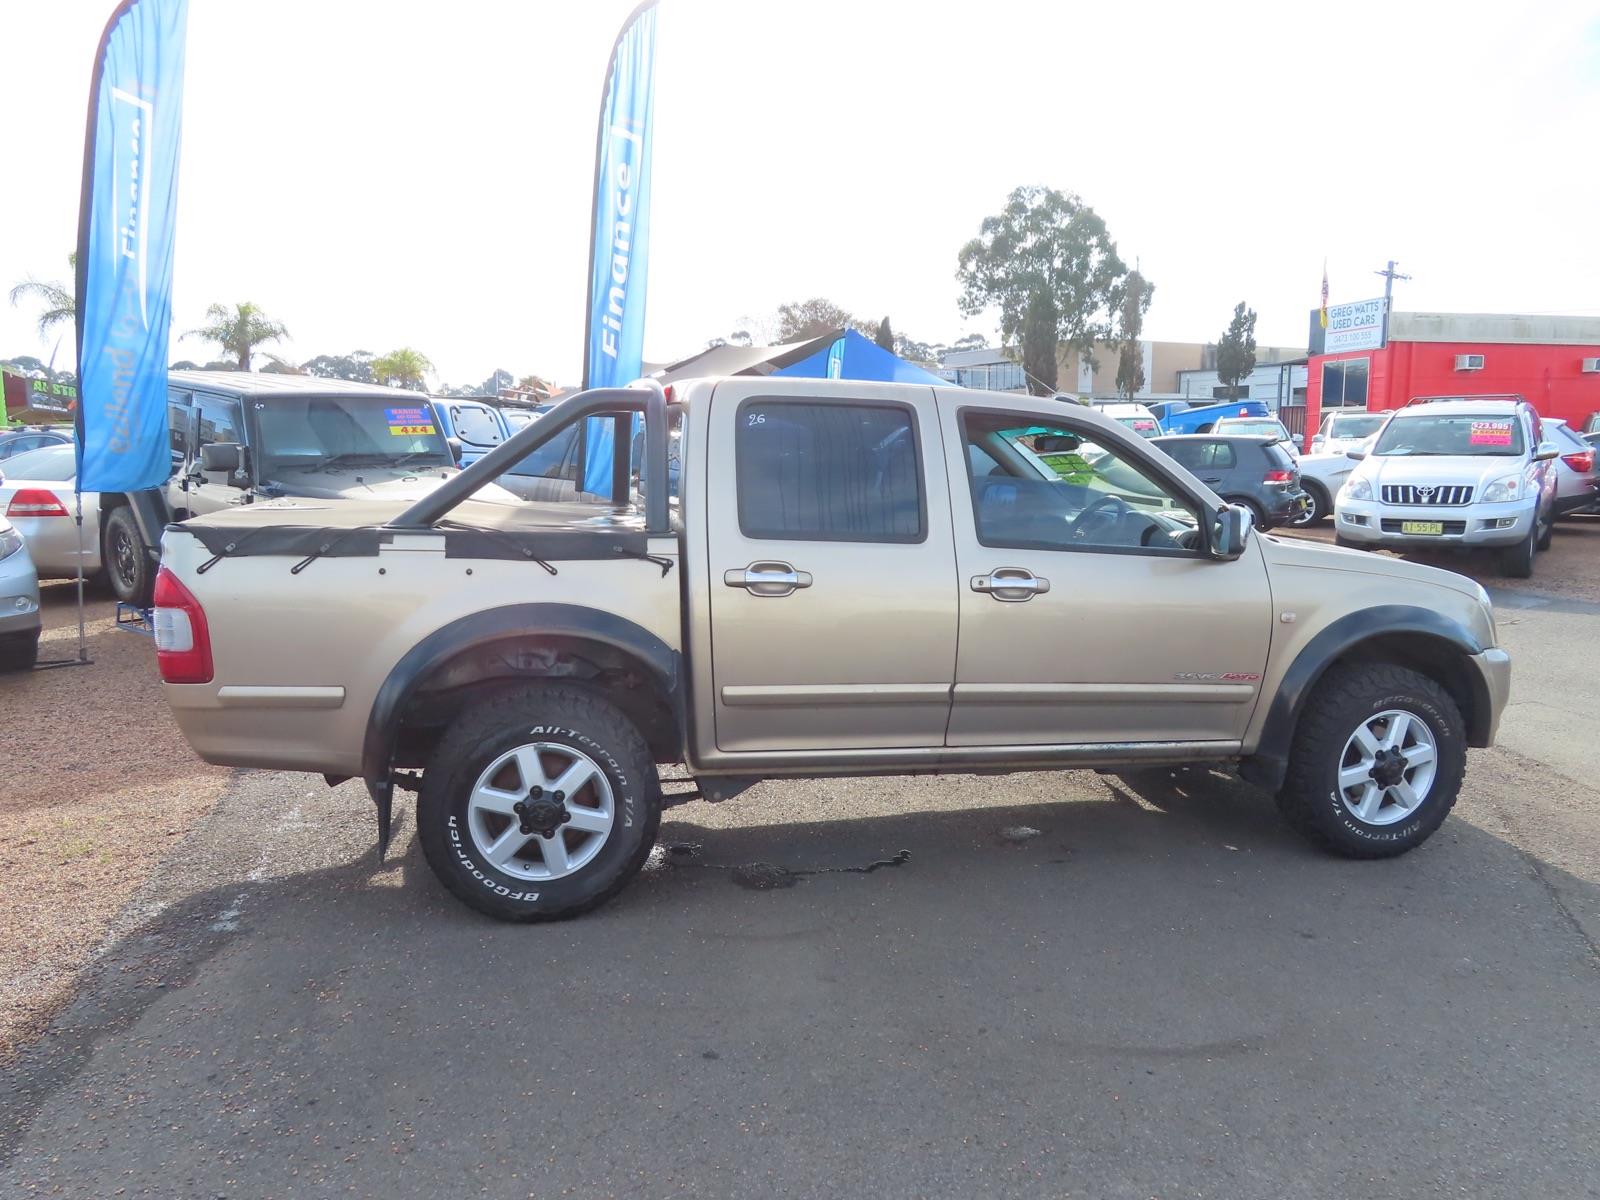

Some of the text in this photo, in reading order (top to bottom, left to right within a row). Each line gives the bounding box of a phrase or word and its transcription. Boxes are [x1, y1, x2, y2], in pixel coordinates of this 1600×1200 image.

[601, 161, 632, 360] Finance
[1330, 301, 1379, 319] GREG WATTS
[1333, 314, 1375, 330] USED CARS
[749, 413, 766, 425] 26
[530, 724, 635, 828] All-Terrain T/A
[447, 814, 541, 902] BFGoodrich
